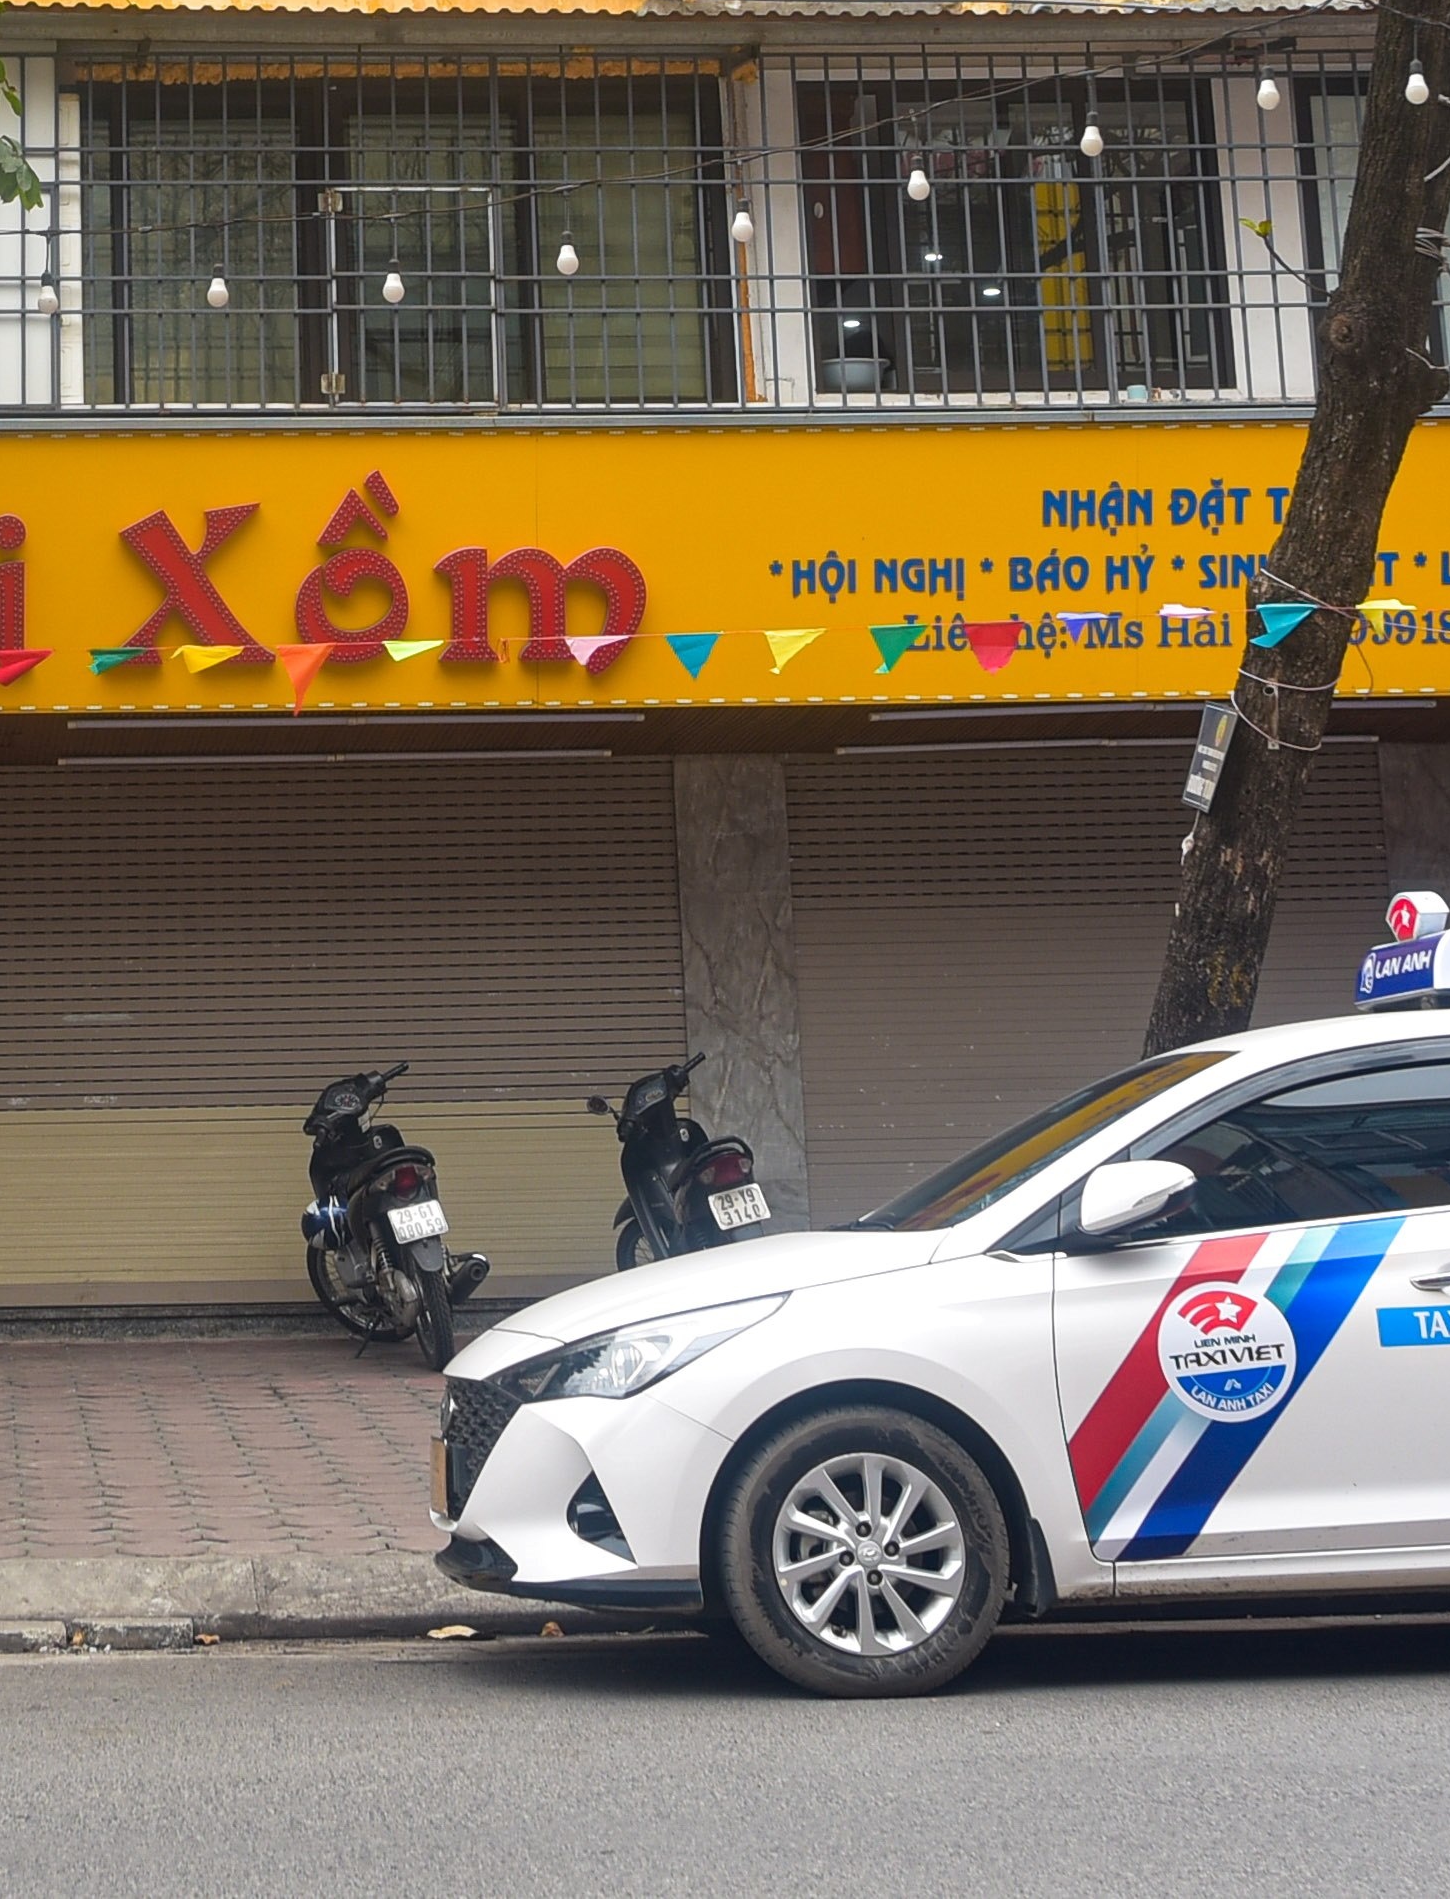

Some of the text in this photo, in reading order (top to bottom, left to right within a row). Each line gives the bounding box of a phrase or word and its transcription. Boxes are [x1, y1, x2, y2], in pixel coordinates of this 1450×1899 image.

[1041, 481, 1154, 537] NHẬN
[1168, 476, 1251, 536] ĐẶT
[119, 469, 647, 675] Xồm
[792, 550, 857, 604] HỘI
[874, 556, 965, 601] NGHỊ
[1008, 548, 1090, 593] BÁO
[1105, 543, 1156, 594] HỶ
[1083, 617, 1144, 649] Ms
[1375, 949, 1433, 979] LAN ANH
[1223, 1333, 1257, 1346] MINH
[1190, 1381, 1276, 1412] LAN ANH TAXI
